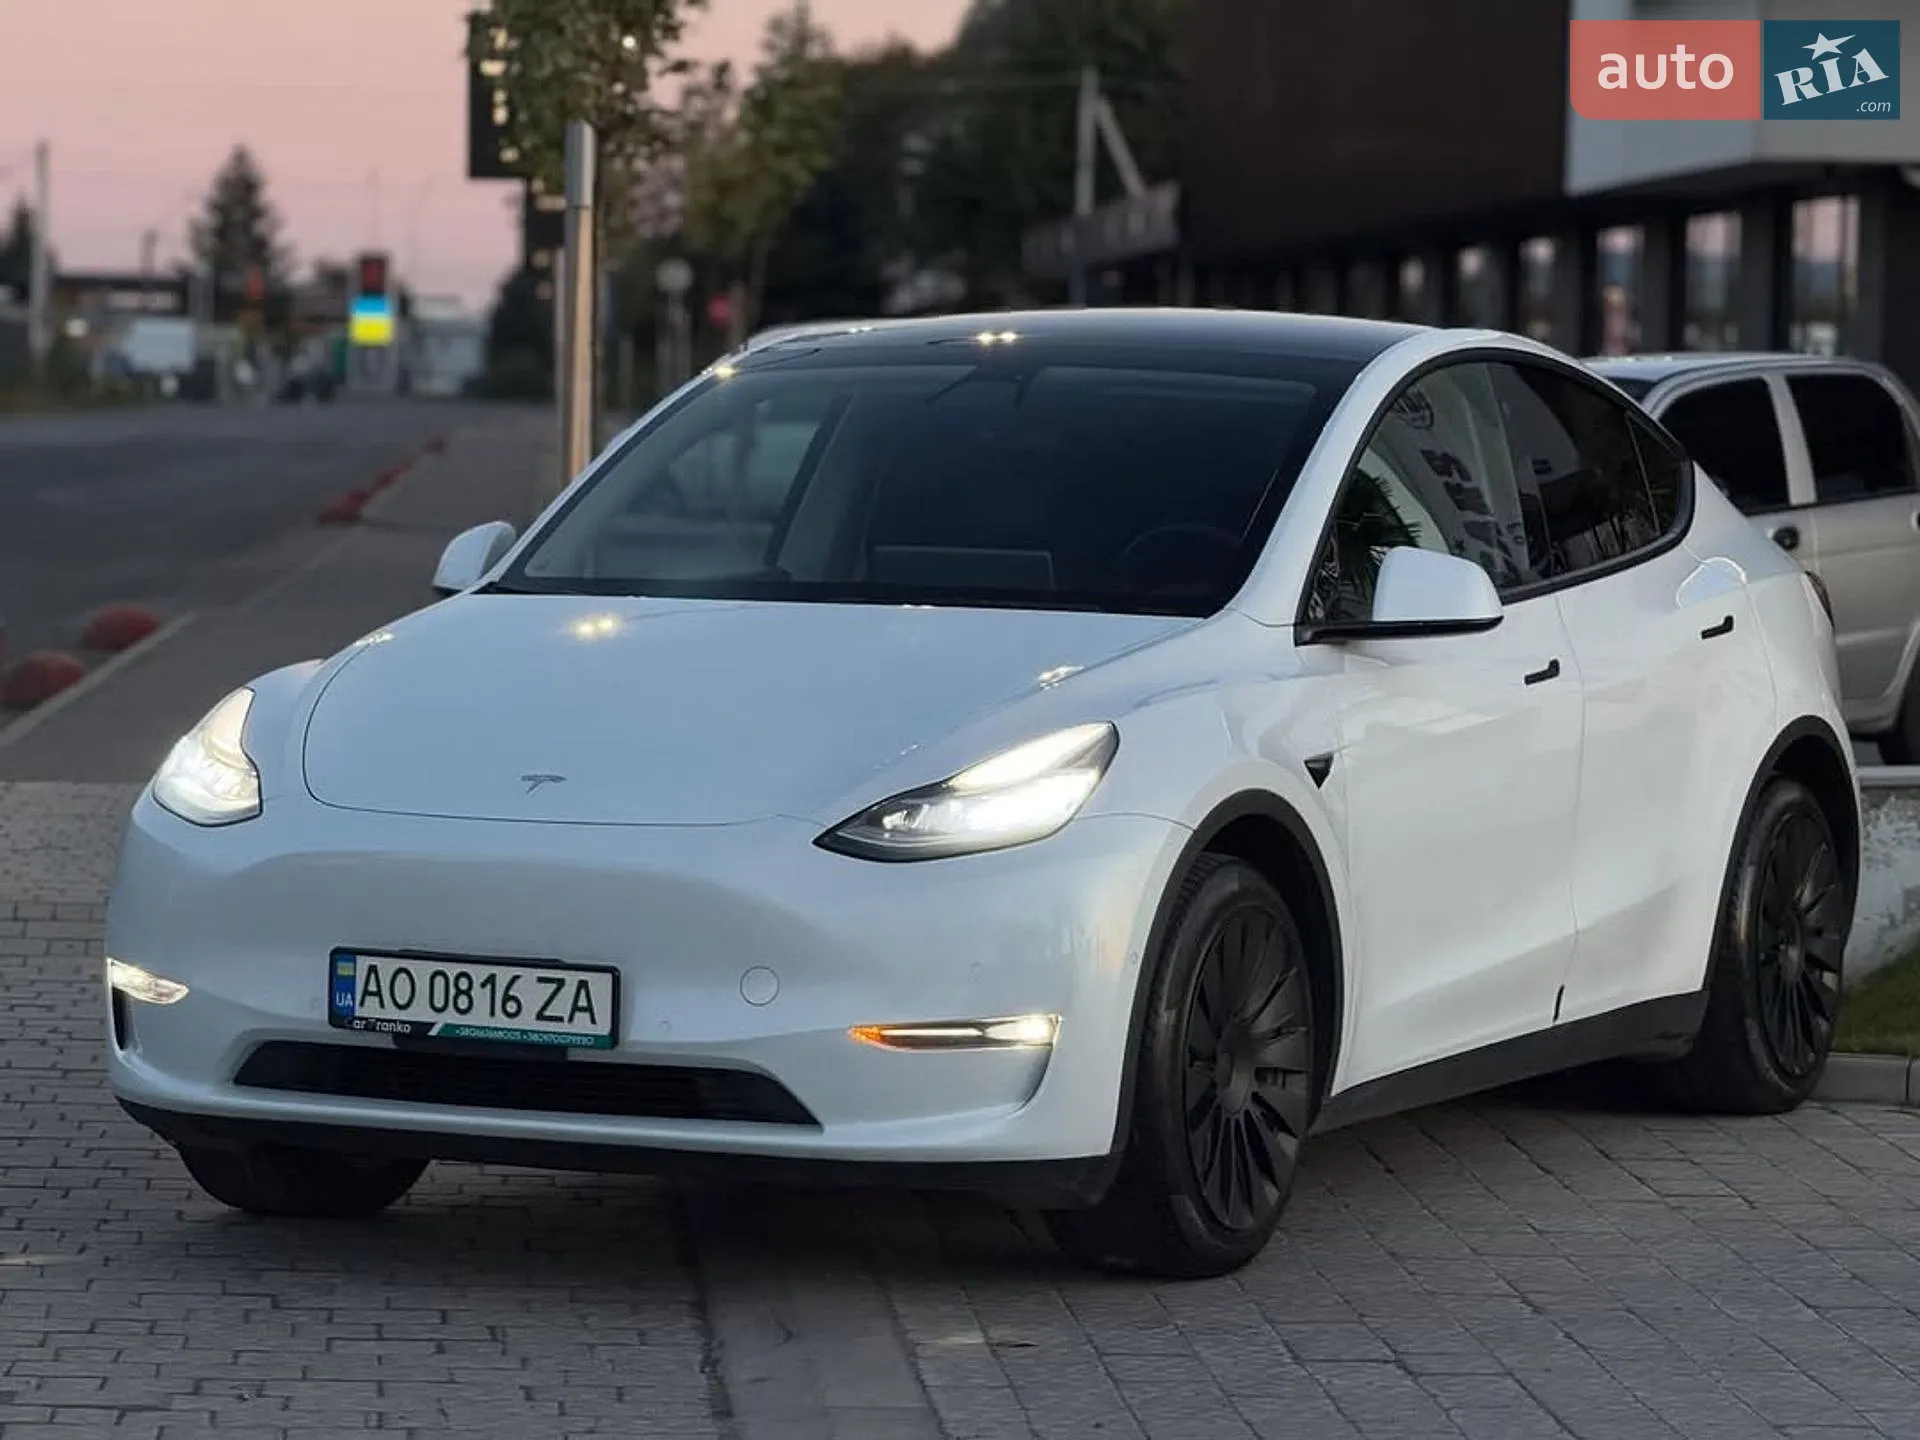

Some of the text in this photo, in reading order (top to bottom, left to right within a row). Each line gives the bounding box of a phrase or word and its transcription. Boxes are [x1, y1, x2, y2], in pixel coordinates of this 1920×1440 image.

[335, 992, 353, 1007] UA
[357, 964, 598, 1026] AO 0816 ZA
